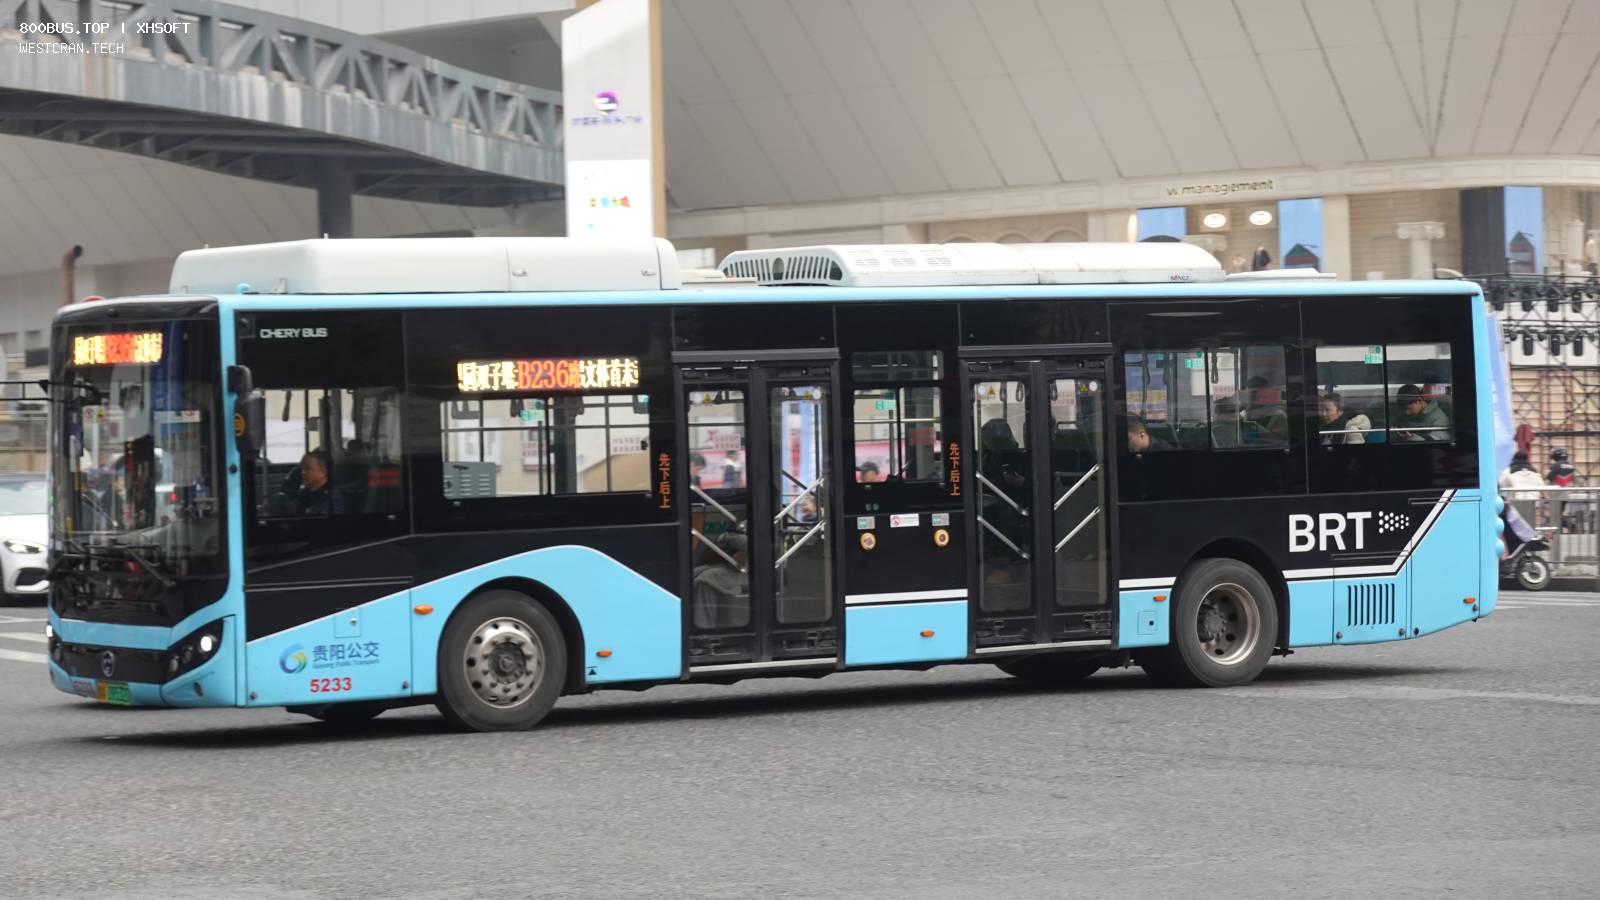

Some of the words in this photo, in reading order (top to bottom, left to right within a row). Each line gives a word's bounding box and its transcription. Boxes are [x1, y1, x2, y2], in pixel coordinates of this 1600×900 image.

[260, 328, 300, 338] CHERY
[302, 327, 328, 338] BUS
[659, 452, 671, 509] 先下后上
[949, 441, 961, 496] 先下后上
[1288, 511, 1372, 553] BRT
[312, 641, 379, 662] 贵阳公交
[310, 677, 352, 693] 5233
